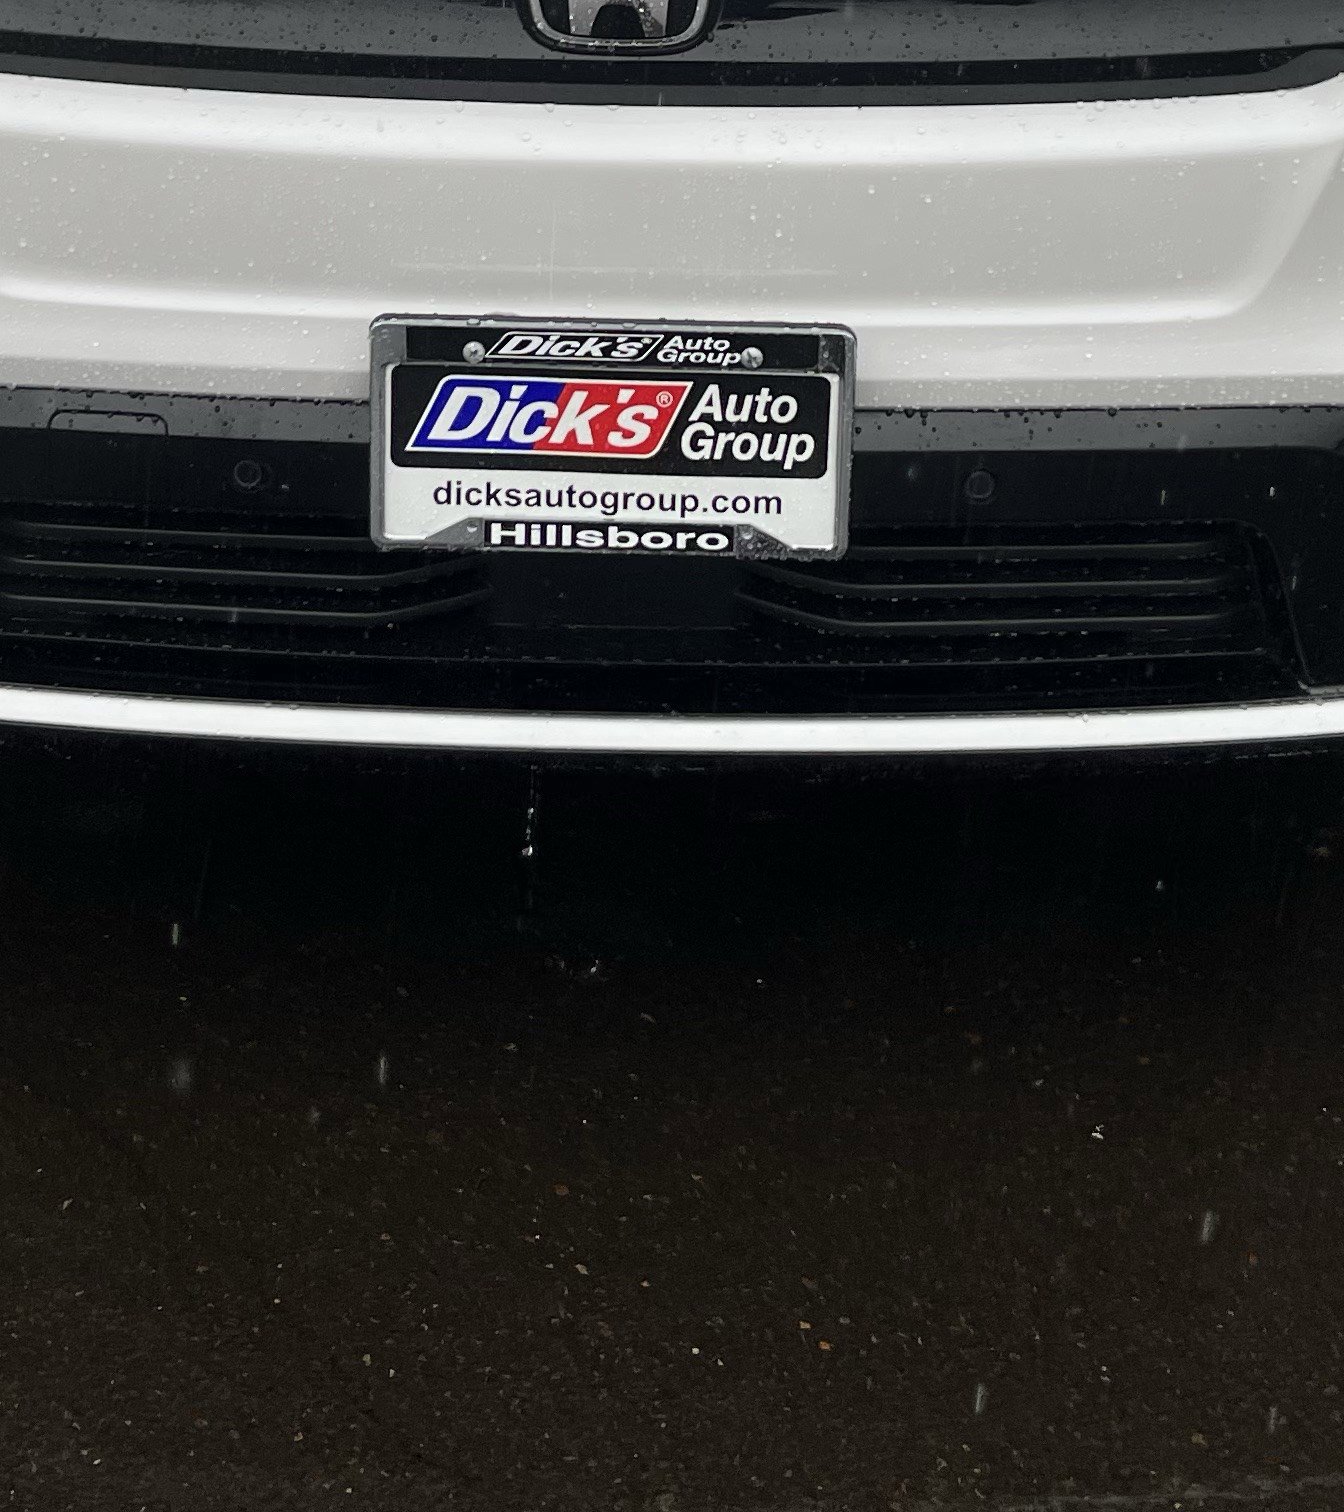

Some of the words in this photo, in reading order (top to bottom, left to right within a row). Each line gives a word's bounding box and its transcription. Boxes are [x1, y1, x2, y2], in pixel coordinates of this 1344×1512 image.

[497, 335, 644, 359] Dick's
[657, 348, 741, 366] Group
[663, 335, 731, 350] Auto
[427, 384, 657, 448] Dick's
[688, 383, 799, 424] Auto
[680, 422, 816, 469] Group
[432, 481, 783, 517] dicksautogroup.com
[489, 523, 730, 550] Hillsboro
